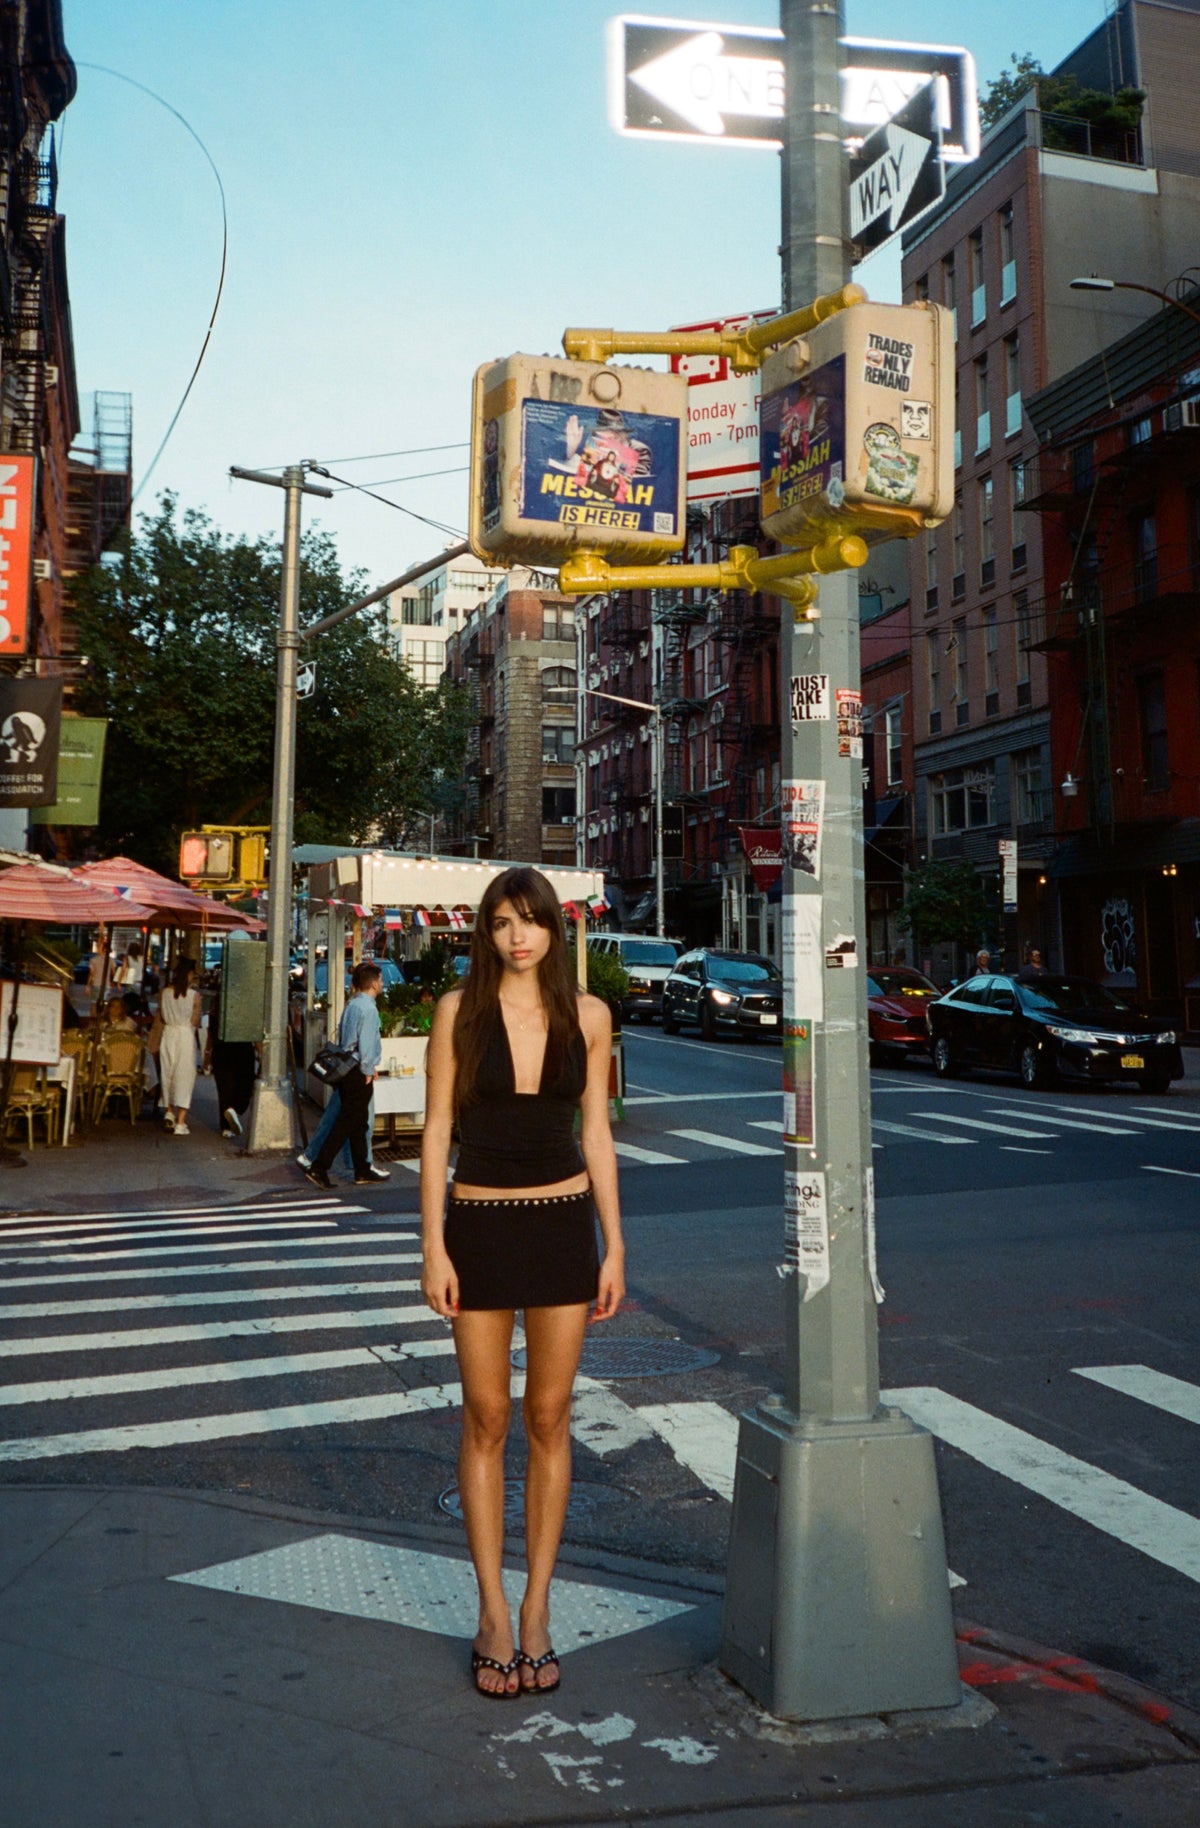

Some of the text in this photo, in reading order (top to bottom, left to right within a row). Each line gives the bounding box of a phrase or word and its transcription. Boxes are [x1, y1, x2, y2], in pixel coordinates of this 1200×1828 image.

[689, 63, 786, 107] ONE
[858, 143, 905, 221] WAY
[868, 333, 914, 358] TRADES
[864, 366, 911, 392] REMAND
[727, 424, 758, 443] 7pm
[562, 506, 640, 529] IS HERE!
[790, 675, 827, 692] MUST
[790, 689, 822, 706] TAKE
[26, 774, 43, 783] FOR
